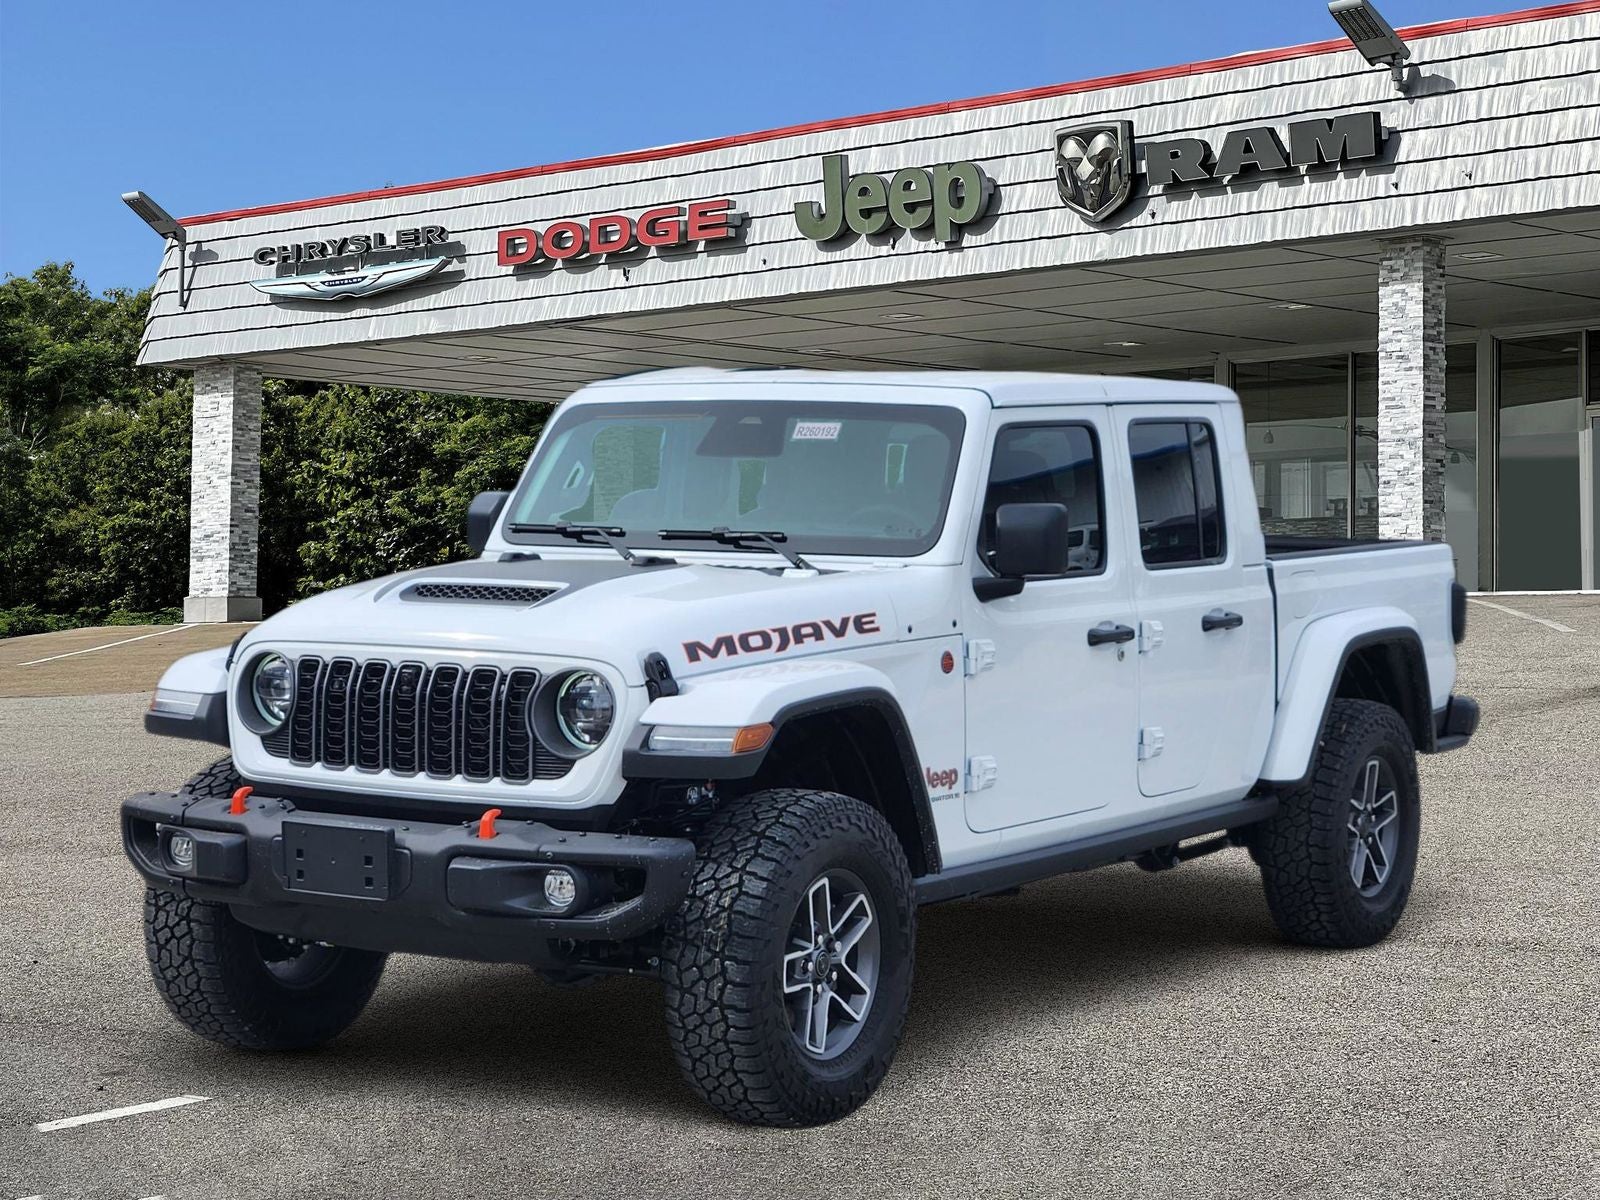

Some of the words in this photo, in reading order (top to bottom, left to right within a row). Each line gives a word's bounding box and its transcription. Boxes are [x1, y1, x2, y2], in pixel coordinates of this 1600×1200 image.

[1146, 111, 1380, 186] RAM
[795, 154, 986, 243] Jeep
[253, 225, 447, 266] CHRYSLER
[497, 199, 736, 267] DODGE
[324, 278, 363, 286] CHRYSLER
[795, 426, 838, 437] R260192
[682, 612, 880, 663] MOJAVE
